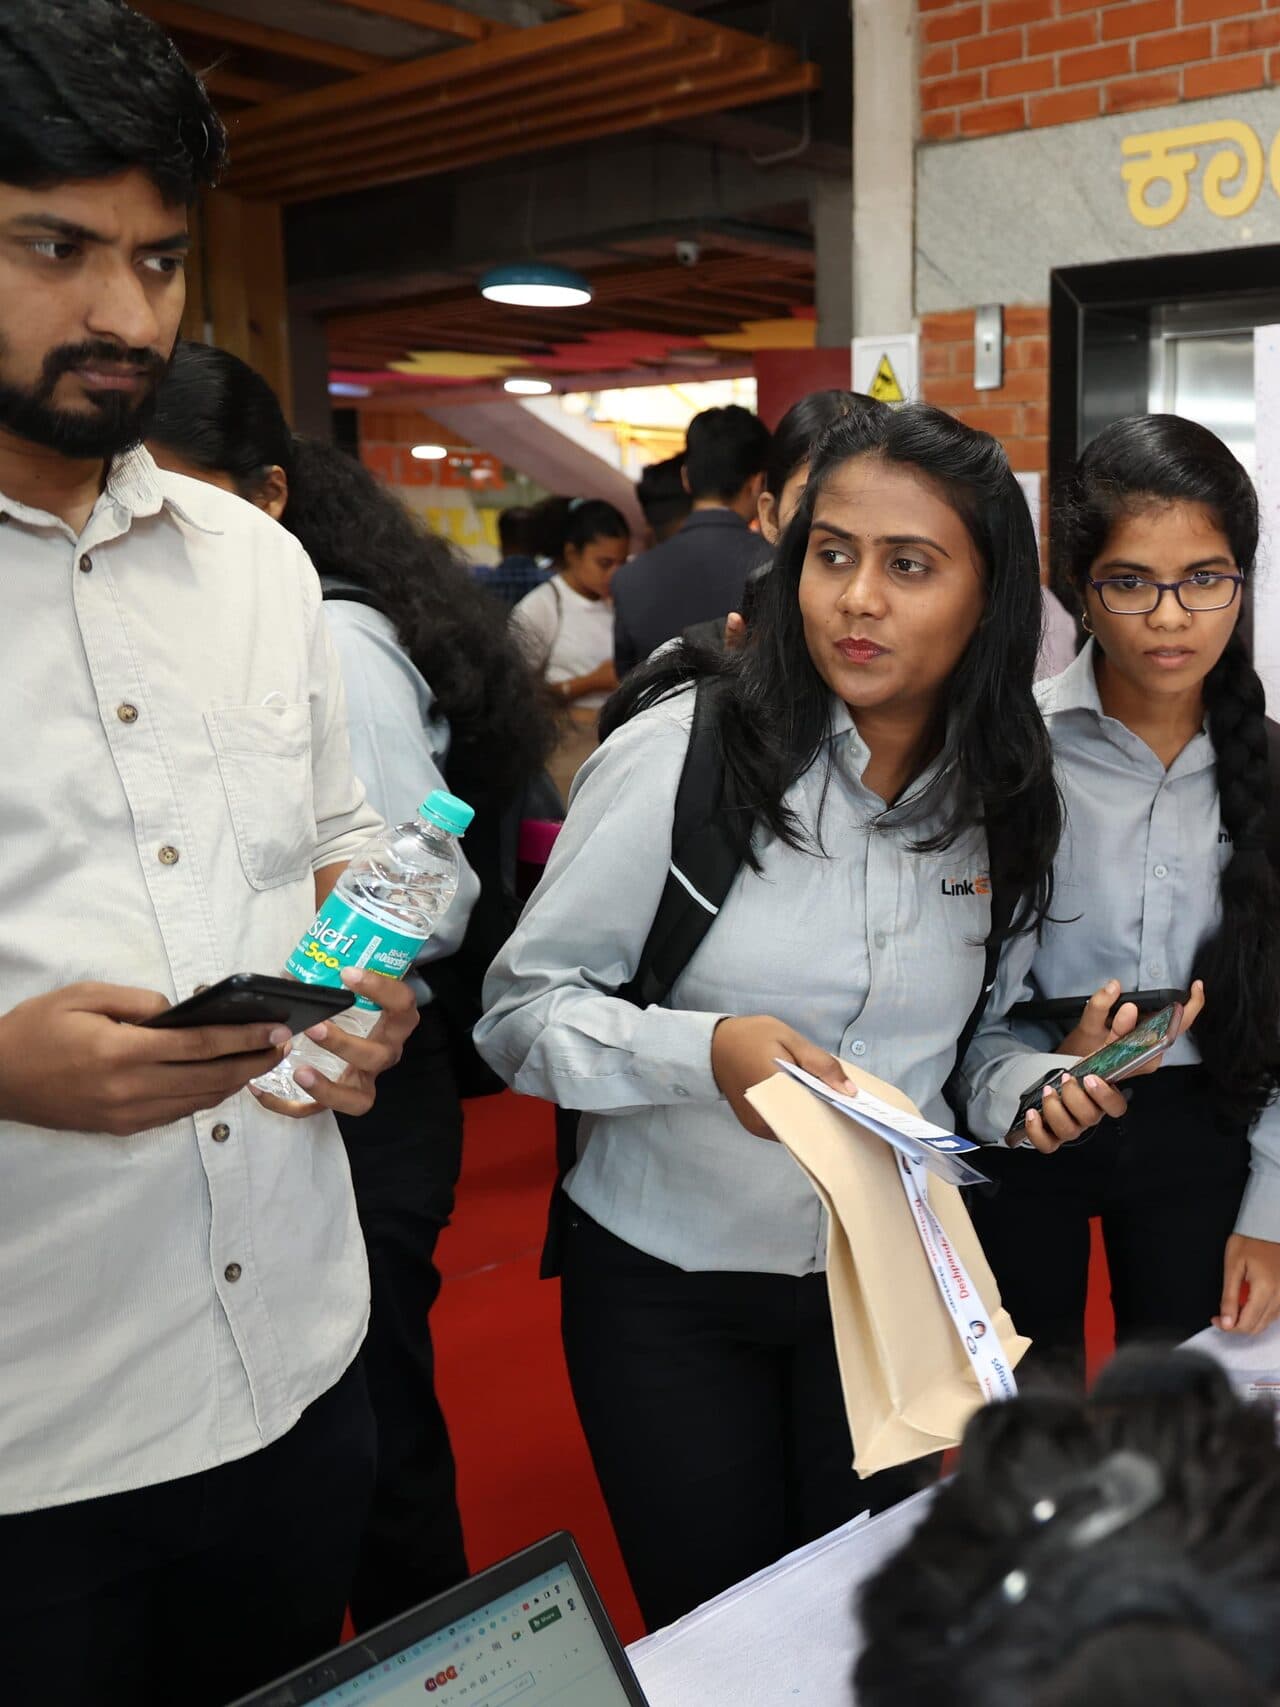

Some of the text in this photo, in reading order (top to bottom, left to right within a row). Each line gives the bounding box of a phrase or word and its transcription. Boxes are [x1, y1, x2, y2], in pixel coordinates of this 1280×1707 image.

[941, 878, 975, 897] Link
[308, 917, 358, 954] sleri
[304, 941, 339, 968] 500
